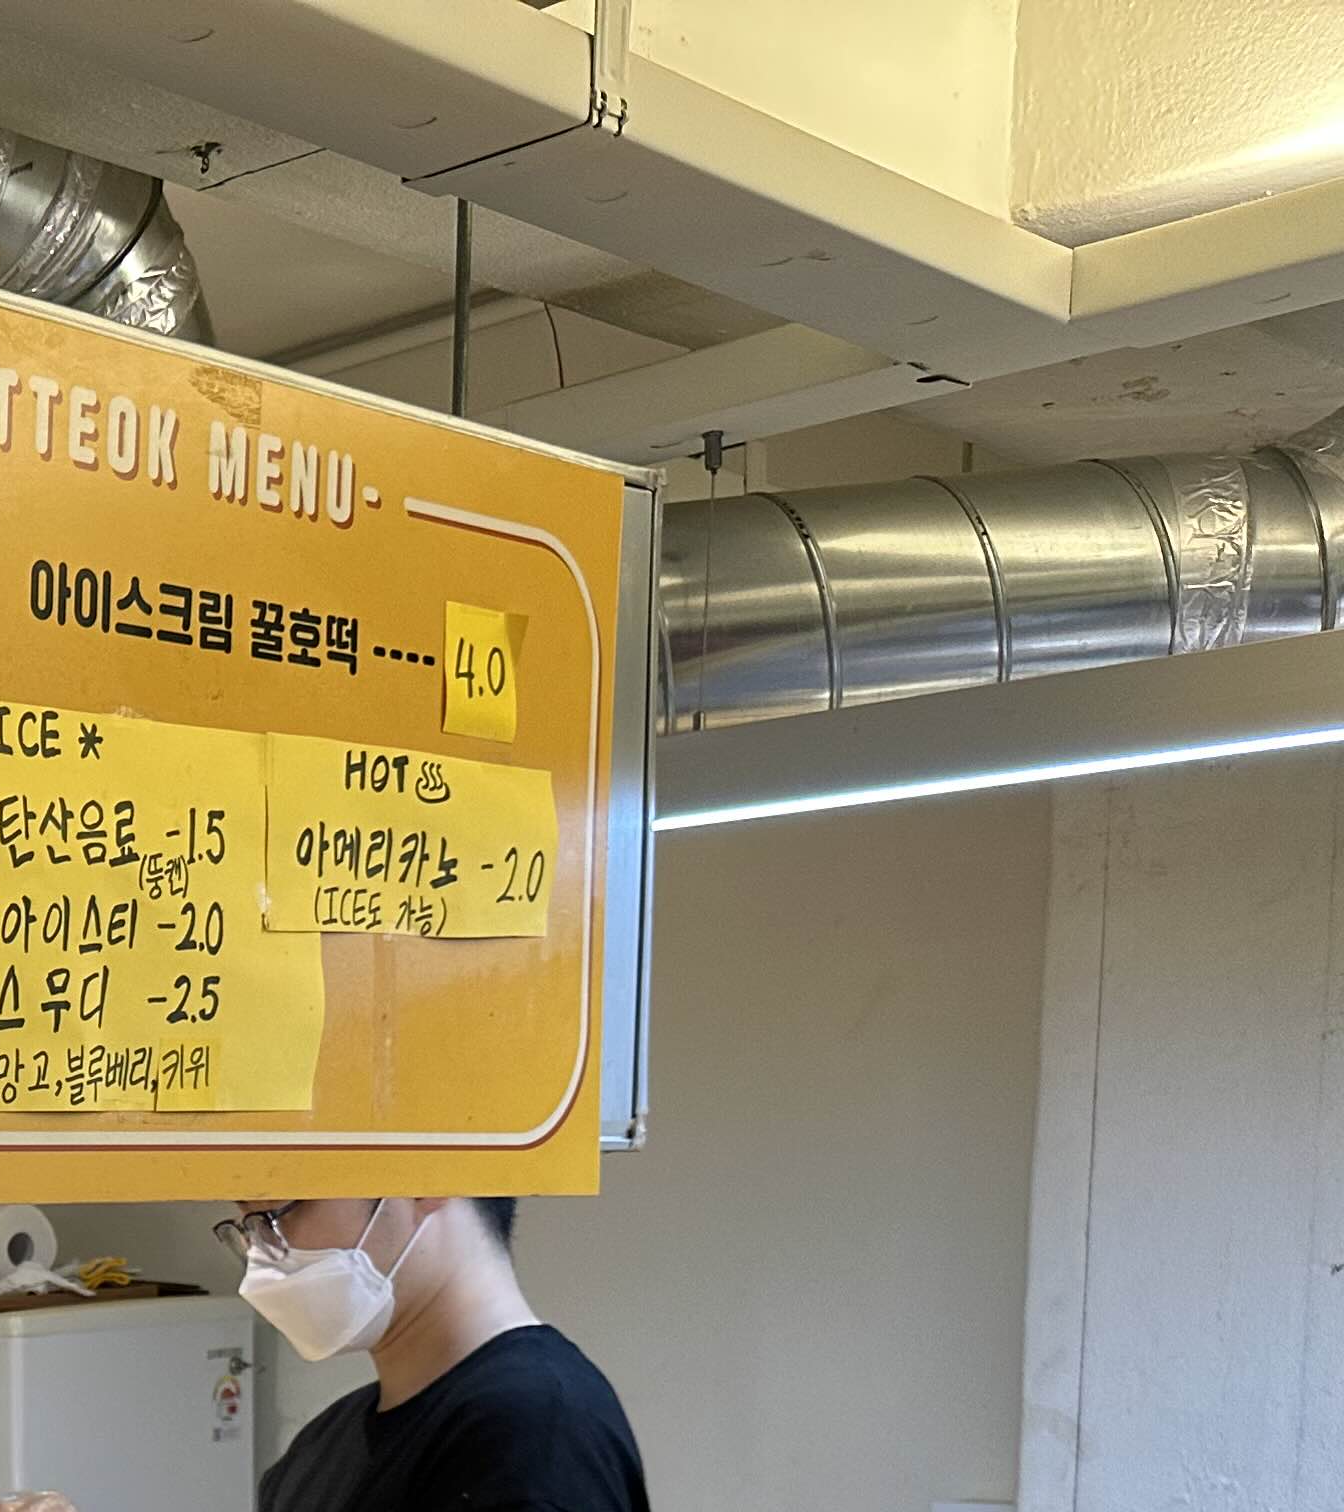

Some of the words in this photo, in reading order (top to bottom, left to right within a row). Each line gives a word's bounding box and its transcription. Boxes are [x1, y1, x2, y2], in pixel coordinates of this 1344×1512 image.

[30, 558, 234, 656] 아이스크림
[250, 598, 359, 675] 꿀호떡
[452, 636, 506, 698] 4.0
[344, 750, 409, 793] HOT
[296, 820, 458, 890] 아메리카노
[2, 895, 138, 954] 아이스티
[396, 894, 448, 936] 가능)
